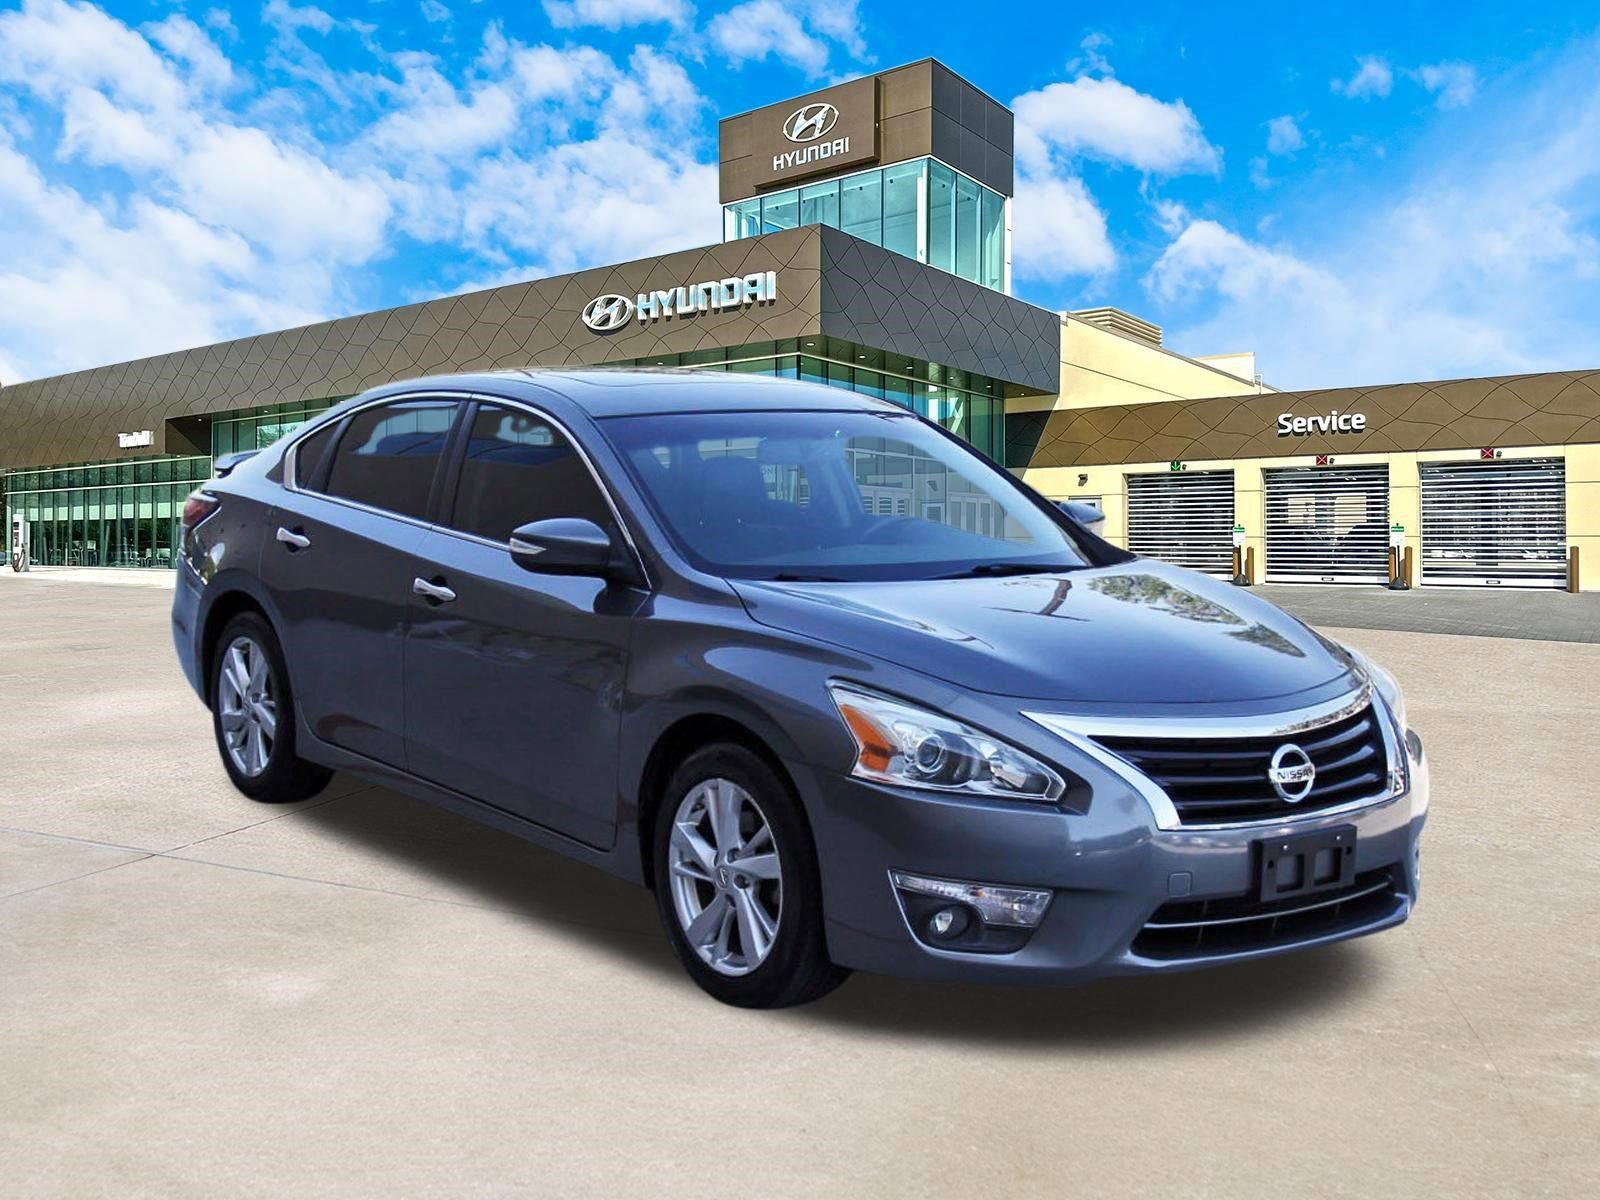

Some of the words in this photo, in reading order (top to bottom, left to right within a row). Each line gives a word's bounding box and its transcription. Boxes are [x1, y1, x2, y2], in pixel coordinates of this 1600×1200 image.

[773, 136, 850, 171] HYUNDAI
[636, 270, 777, 321] HYUNDAI
[1278, 410, 1366, 434] Service
